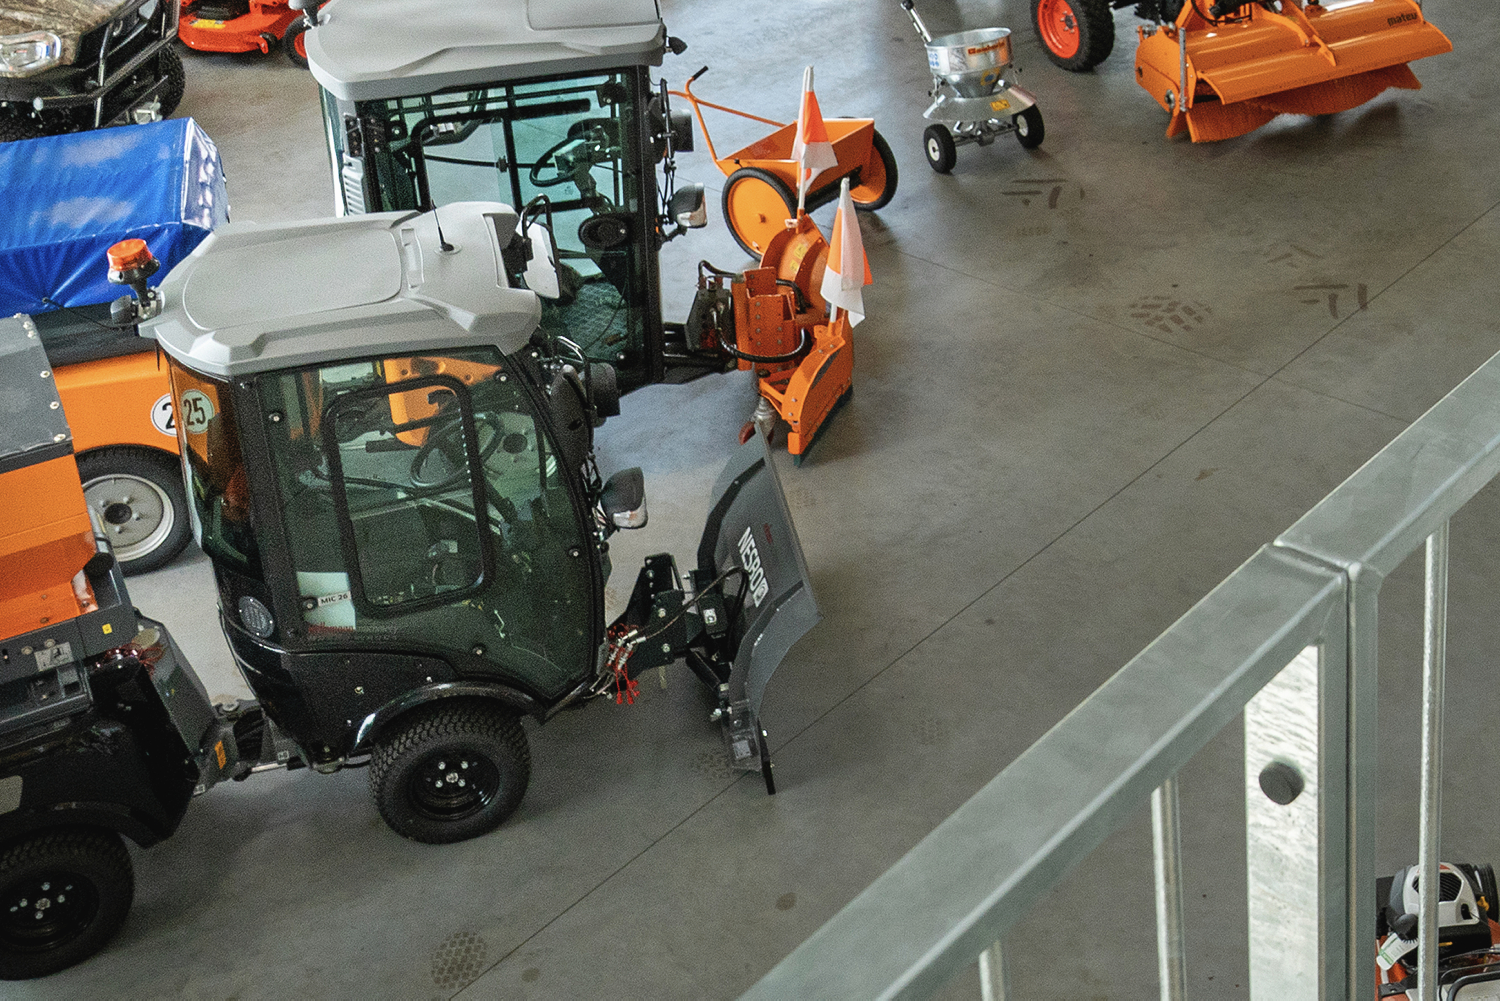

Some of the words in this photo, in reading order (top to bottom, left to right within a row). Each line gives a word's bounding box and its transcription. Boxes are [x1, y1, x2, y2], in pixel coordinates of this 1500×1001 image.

[183, 397, 206, 426] 25
[320, 595, 337, 605] MIC
[338, 593, 349, 601] 26
